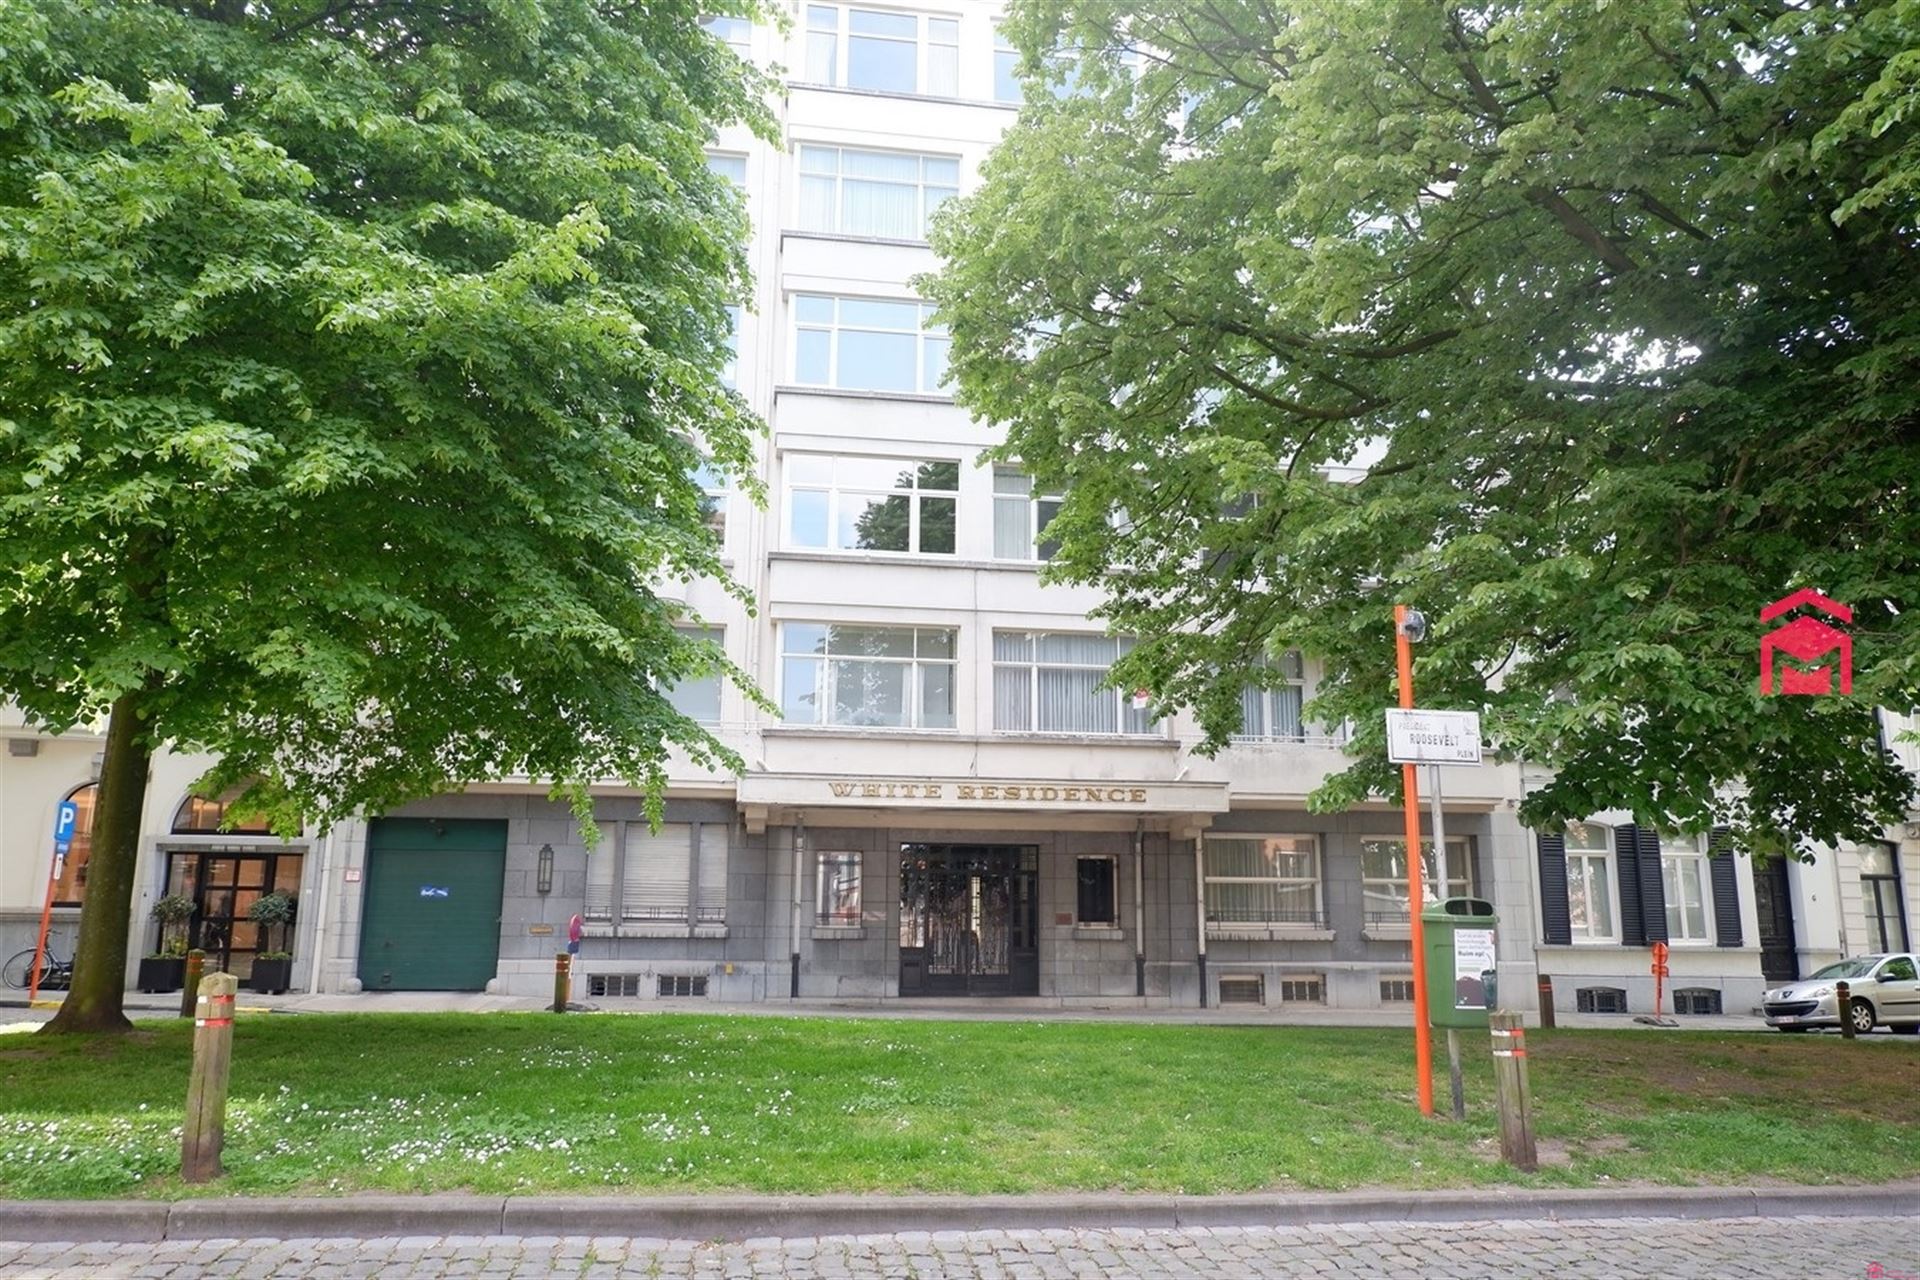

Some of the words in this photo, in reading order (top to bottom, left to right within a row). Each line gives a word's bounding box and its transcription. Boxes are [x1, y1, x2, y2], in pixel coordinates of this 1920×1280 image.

[1409, 733, 1460, 747] ROOSEVELT
[1457, 749, 1474, 758] PLEIN
[828, 782, 942, 799] WHITE
[957, 784, 1147, 803] RESIDENCE
[58, 807, 74, 834] P
